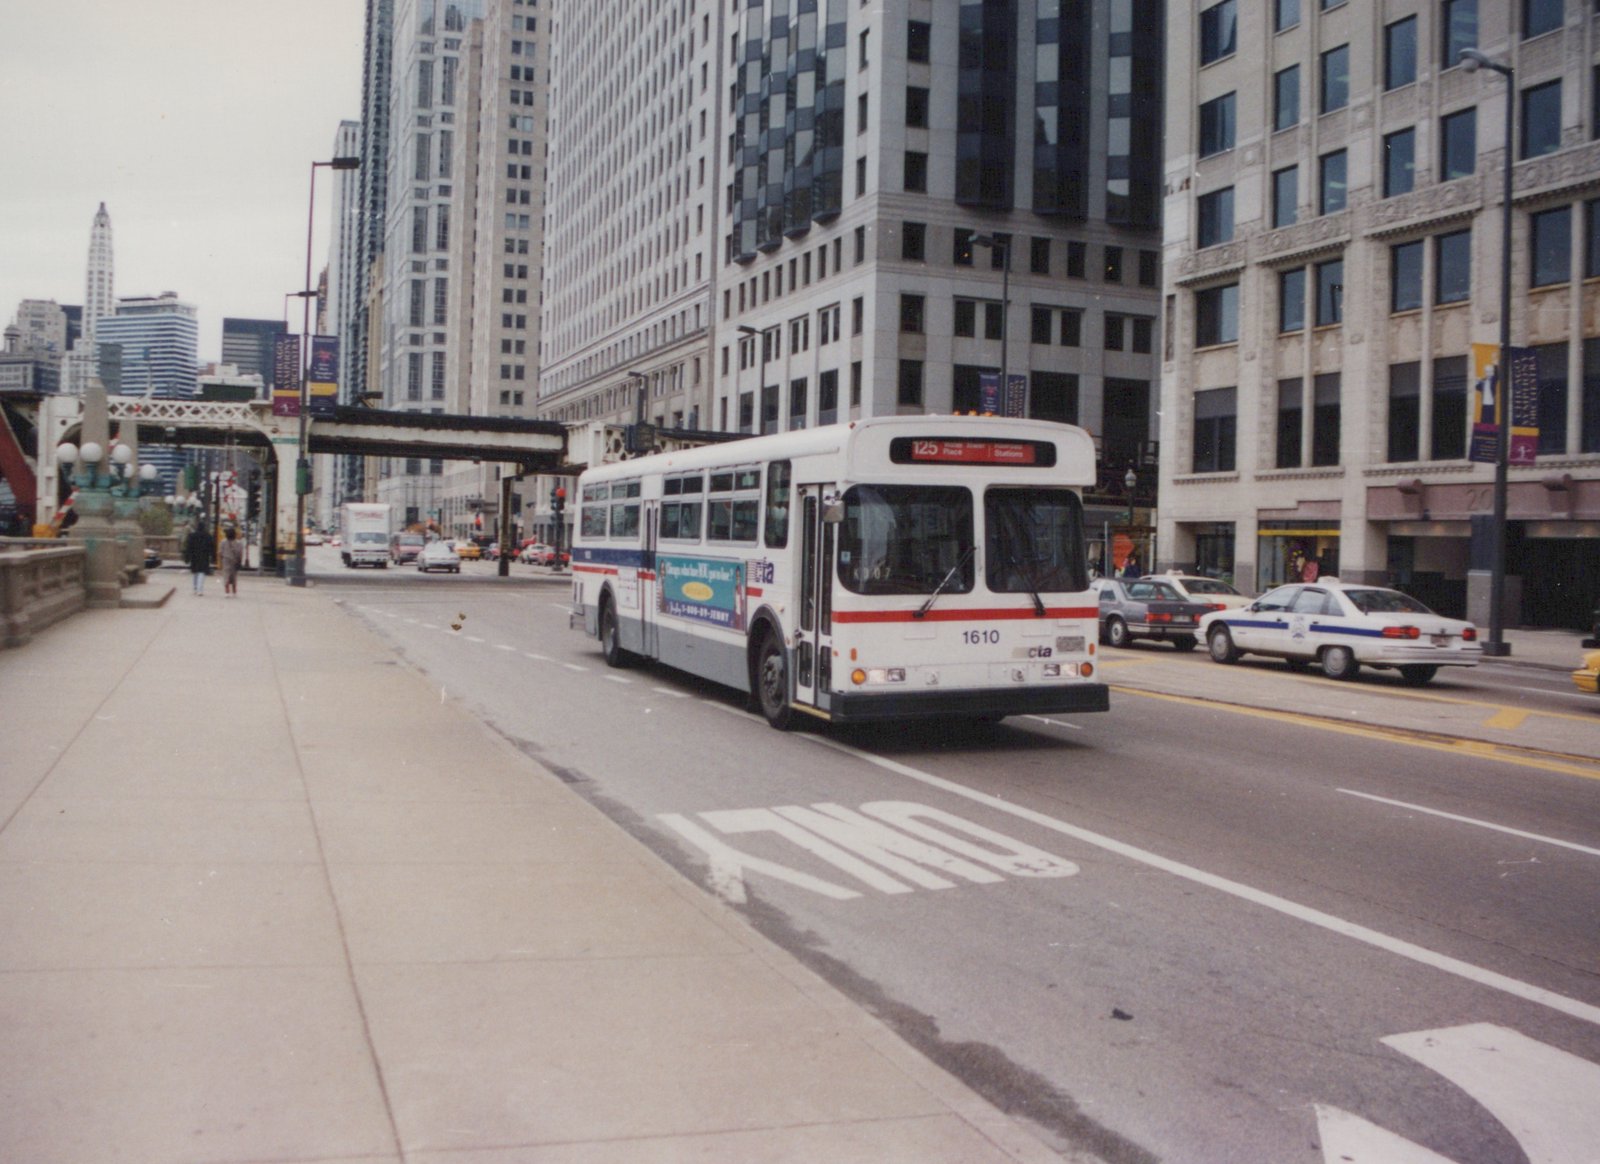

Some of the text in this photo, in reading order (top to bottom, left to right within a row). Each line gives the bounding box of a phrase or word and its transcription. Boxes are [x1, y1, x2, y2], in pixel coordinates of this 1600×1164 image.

[913, 441, 938, 455] 125
[943, 448, 962, 456] Place
[994, 449, 1023, 458] Stations
[963, 630, 1000, 644] 1610
[1028, 646, 1052, 658] cta
[655, 801, 1080, 903] ONLY
